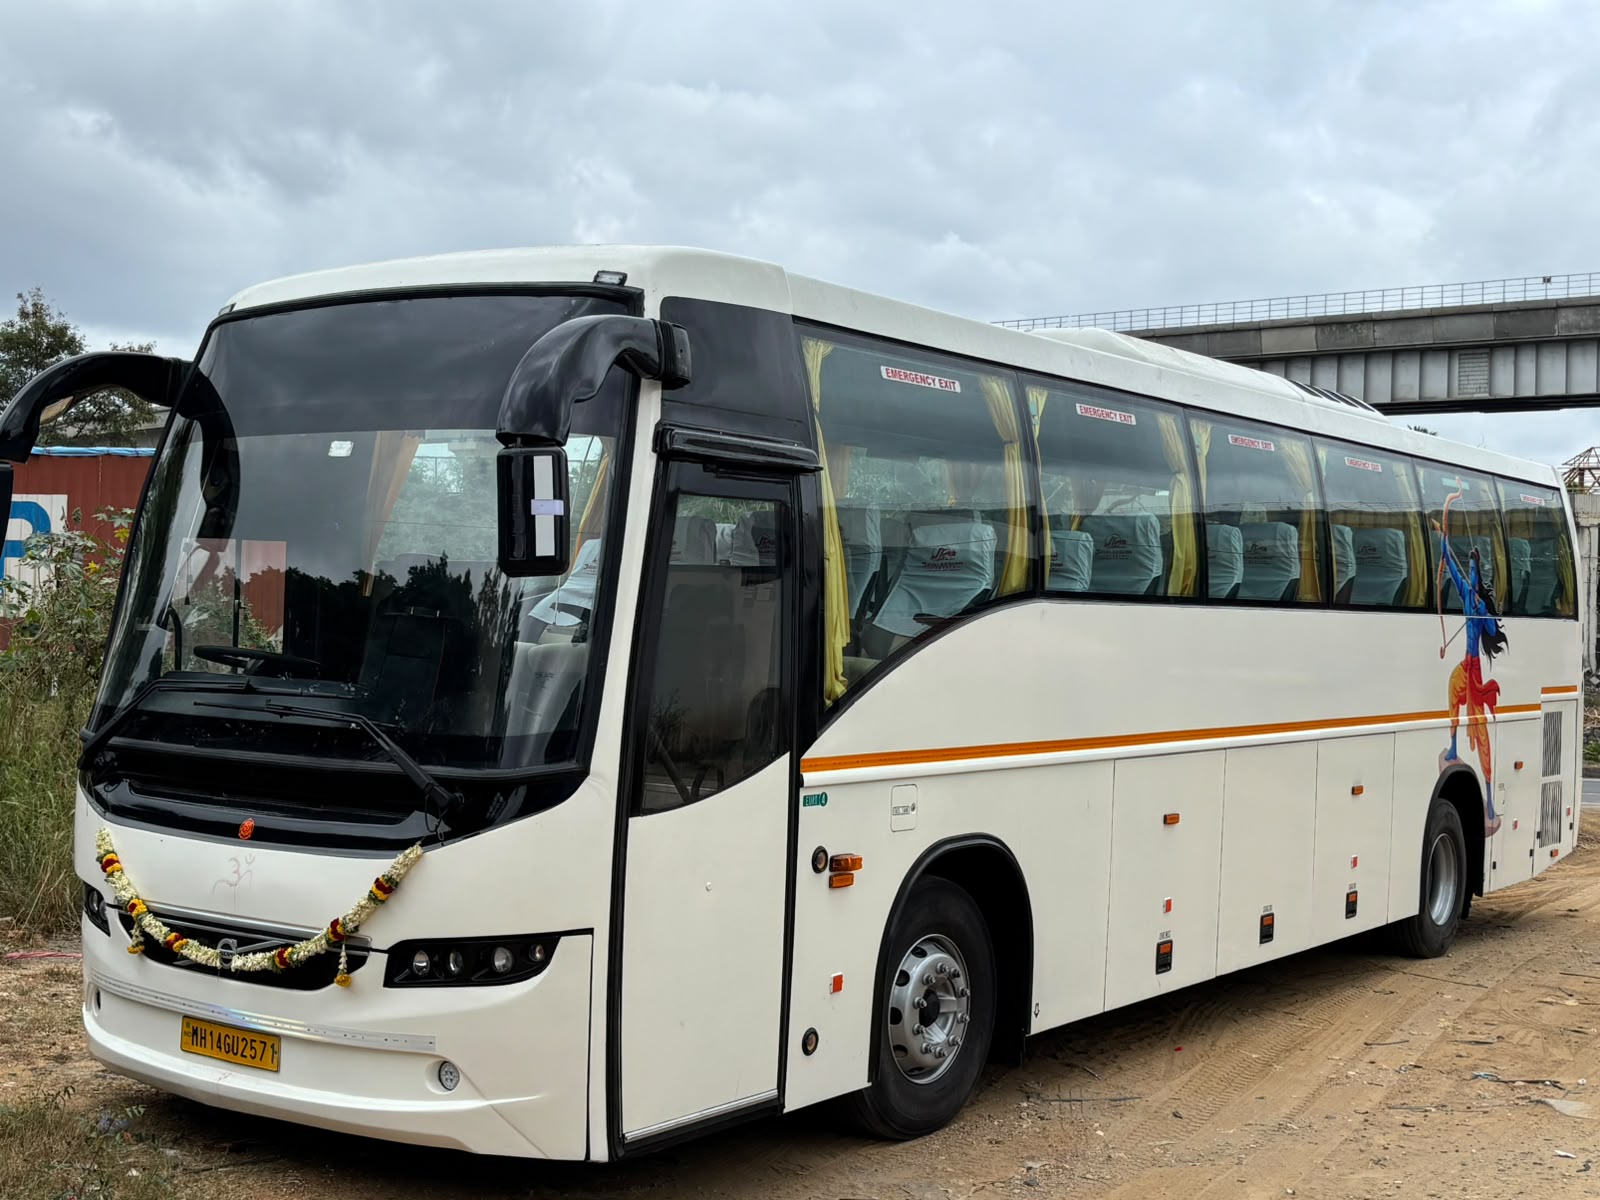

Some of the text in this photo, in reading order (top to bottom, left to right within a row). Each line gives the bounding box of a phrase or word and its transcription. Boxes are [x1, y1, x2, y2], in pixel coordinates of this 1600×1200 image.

[885, 367, 956, 391] EMERGENCY EXIT
[1080, 405, 1133, 424] EMERGENCY EXIT
[192, 1025, 275, 1065] MH14GU2571
